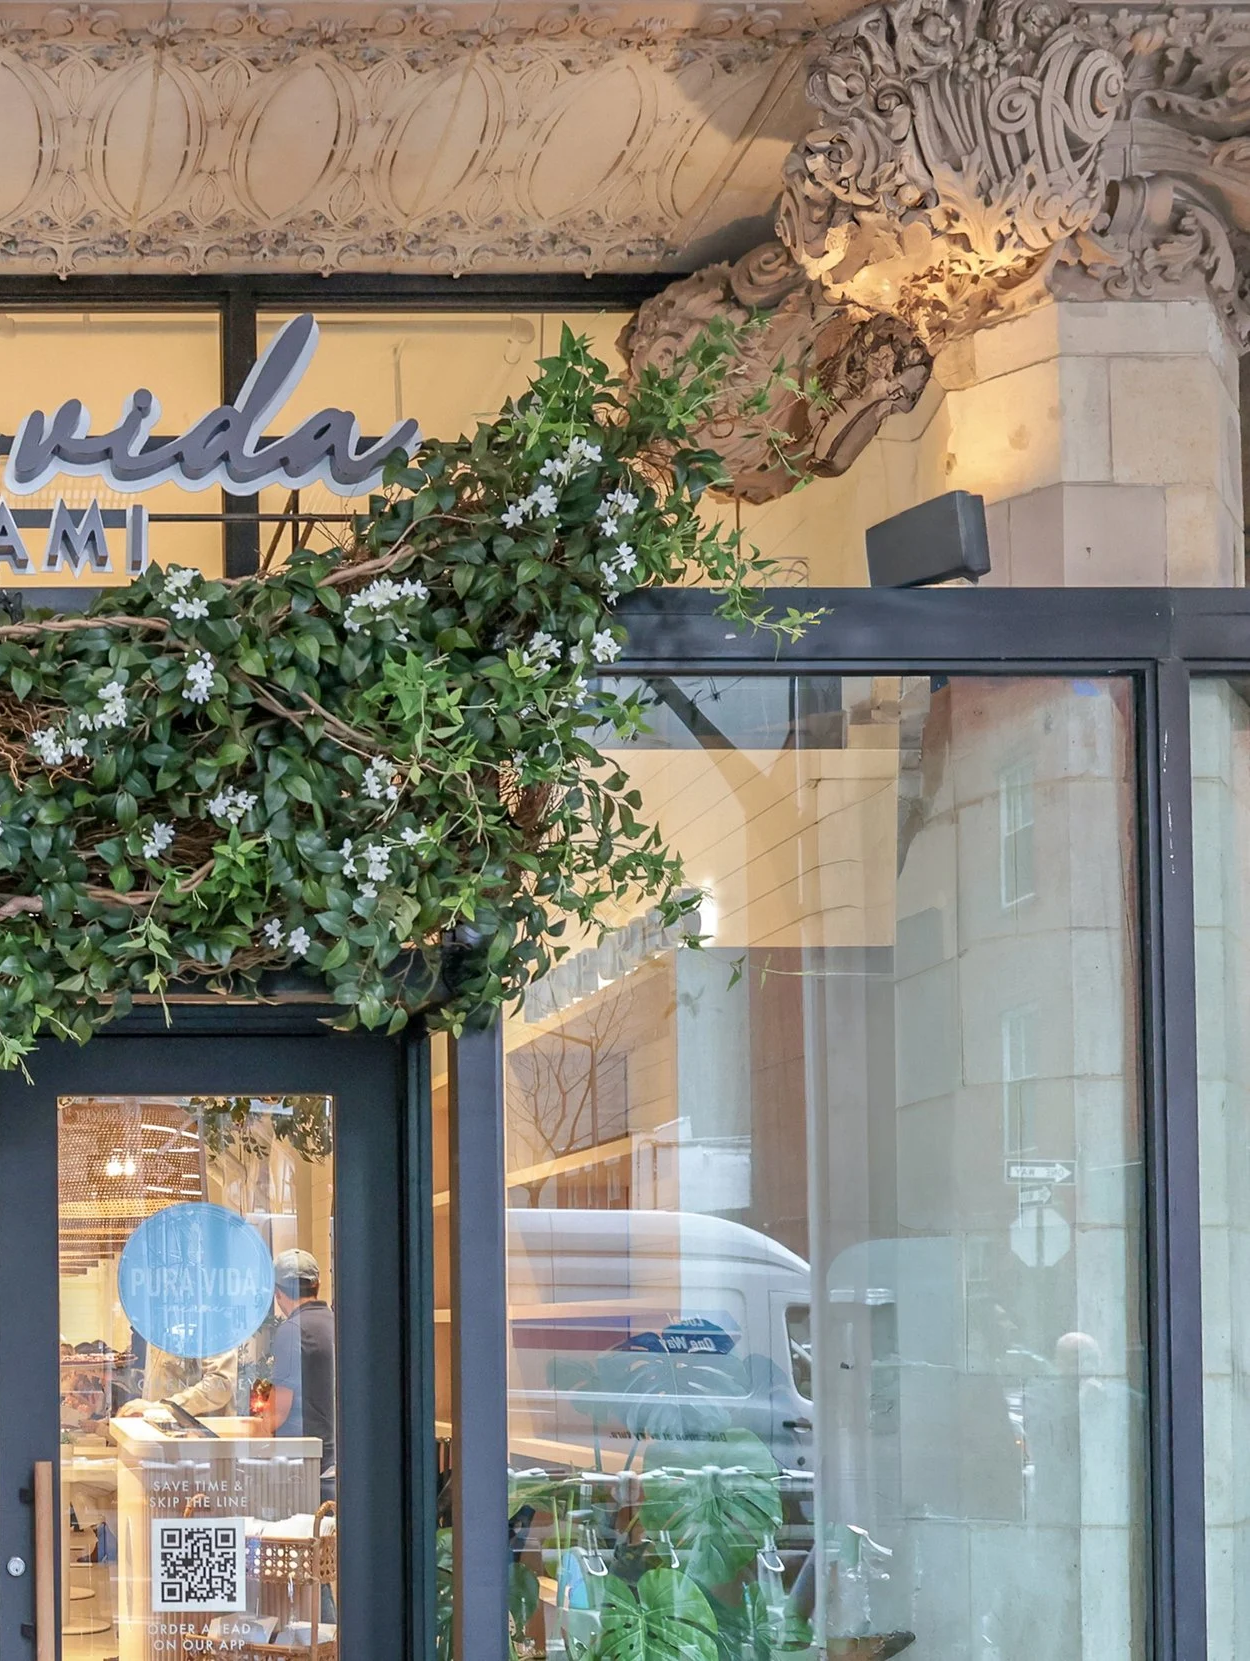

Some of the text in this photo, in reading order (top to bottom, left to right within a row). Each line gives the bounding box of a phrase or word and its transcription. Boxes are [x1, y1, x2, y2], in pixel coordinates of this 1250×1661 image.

[5, 313, 422, 497] vida
[131, 1268, 257, 1297] PURA VIDA
[153, 1480, 243, 1492] SAVE TIME &
[149, 1496, 248, 1507] SKIP THE LINE
[148, 1623, 195, 1635] ORDER
[153, 1639, 246, 1651] ON OUR APP
